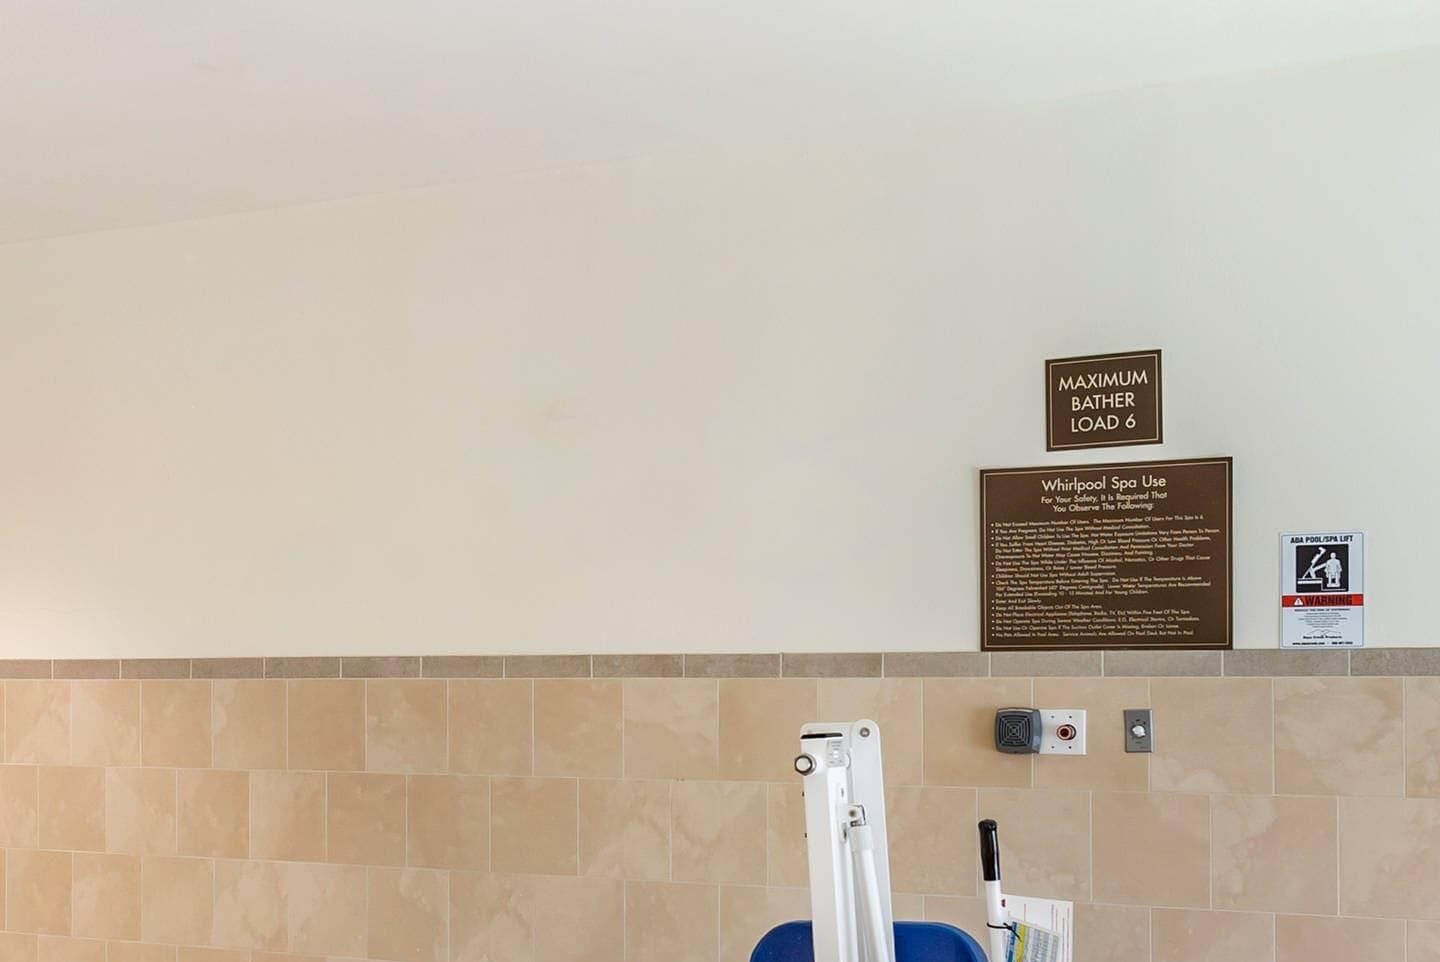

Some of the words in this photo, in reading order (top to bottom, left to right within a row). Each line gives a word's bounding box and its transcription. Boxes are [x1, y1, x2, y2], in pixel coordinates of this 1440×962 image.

[1059, 370, 1148, 391] MAXIMUM
[1071, 392, 1135, 411] BATHER
[1071, 415, 1119, 432] LOAD
[1125, 413, 1136, 428] 6
[1041, 476, 1106, 494] Whirlpool
[1111, 476, 1137, 492] Spa
[1142, 475, 1167, 488] Use
[1041, 496, 1053, 504] For
[1055, 495, 1072, 503] Your
[1116, 491, 1149, 503] Required
[1151, 490, 1168, 499] That
[1053, 504, 1067, 512] You
[1068, 502, 1100, 512] Observe
[1102, 502, 1115, 511] The
[1305, 594, 1352, 607] WARNING
